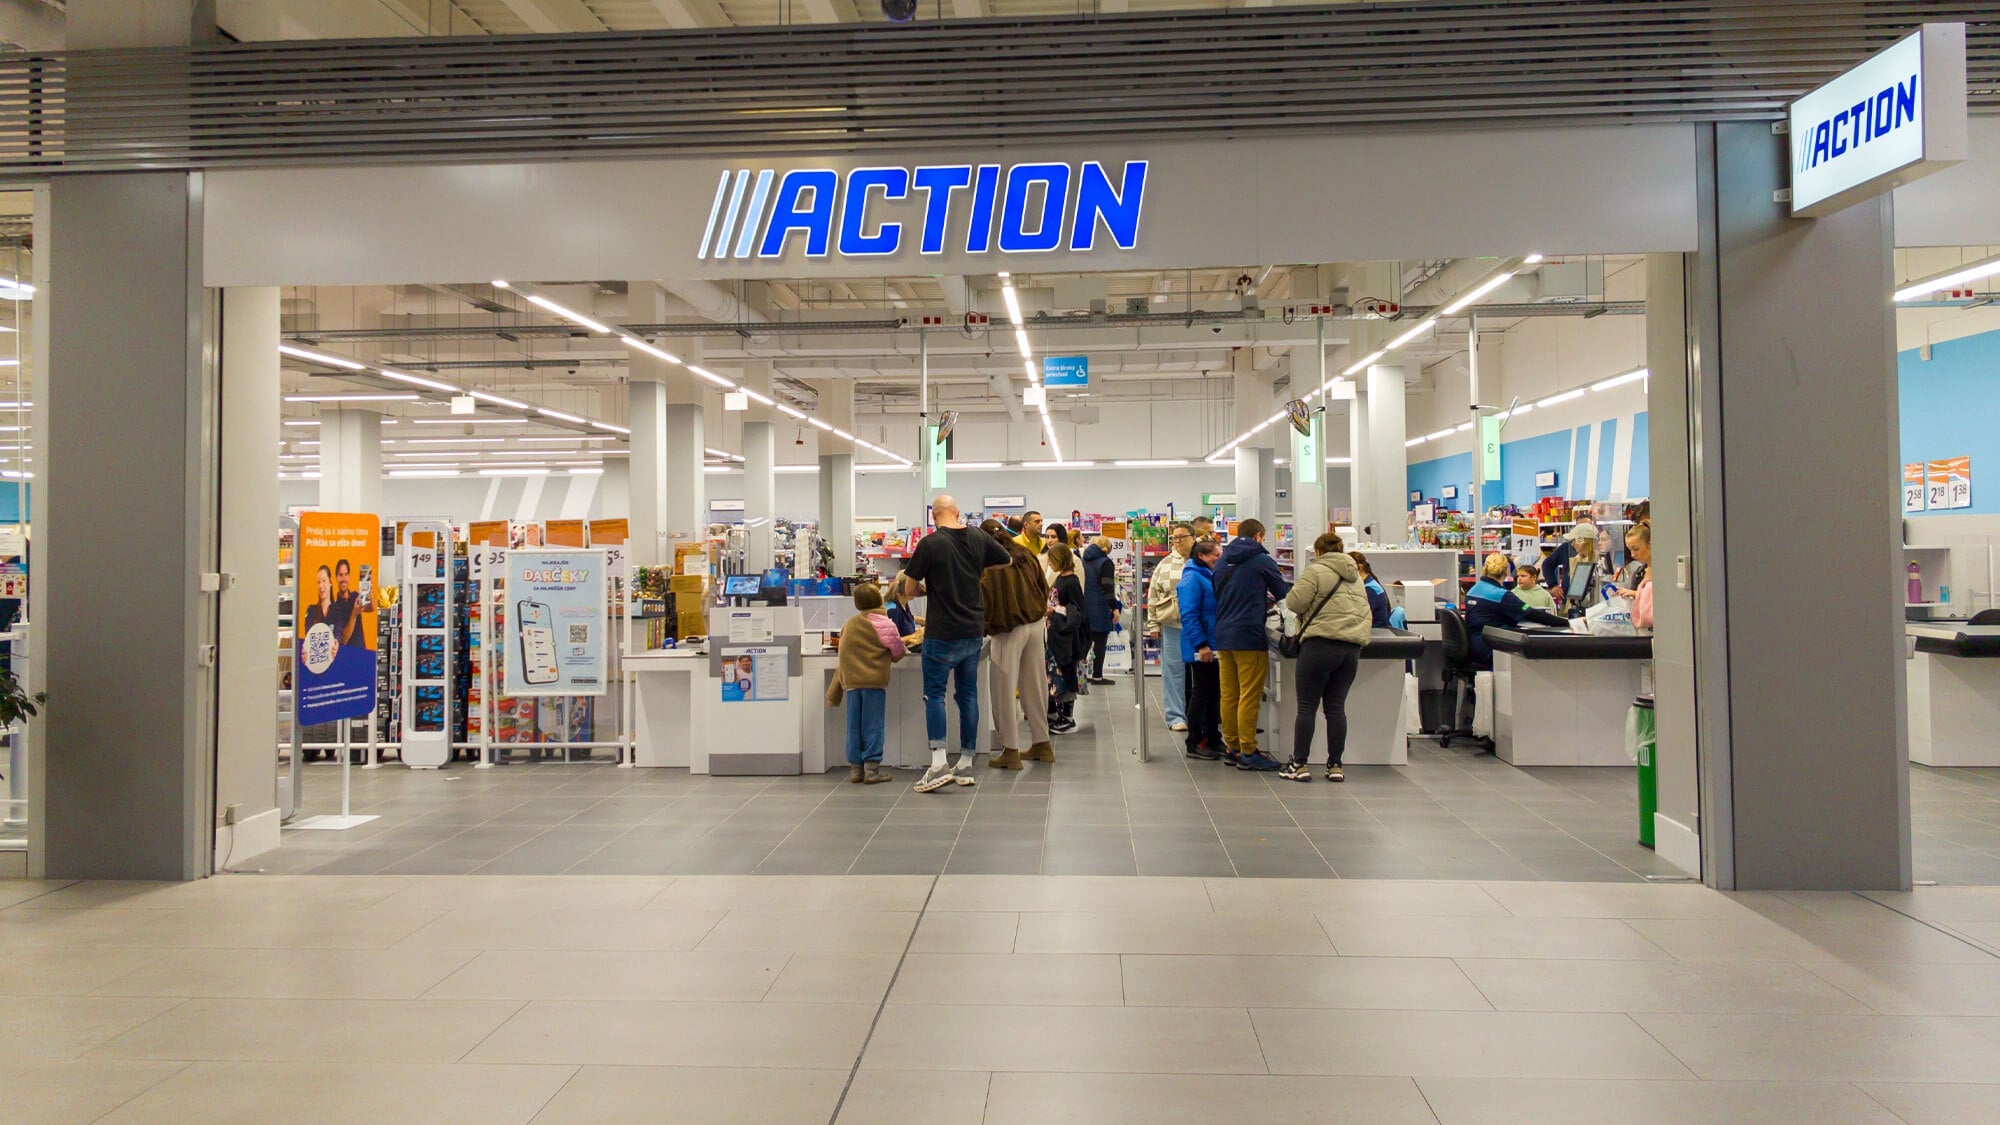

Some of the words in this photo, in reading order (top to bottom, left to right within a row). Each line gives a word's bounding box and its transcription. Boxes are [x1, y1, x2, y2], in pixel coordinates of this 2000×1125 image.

[1812, 74, 1917, 168] ACTION
[758, 160, 1149, 257] ACTION
[523, 566, 590, 583] DARČEKY
